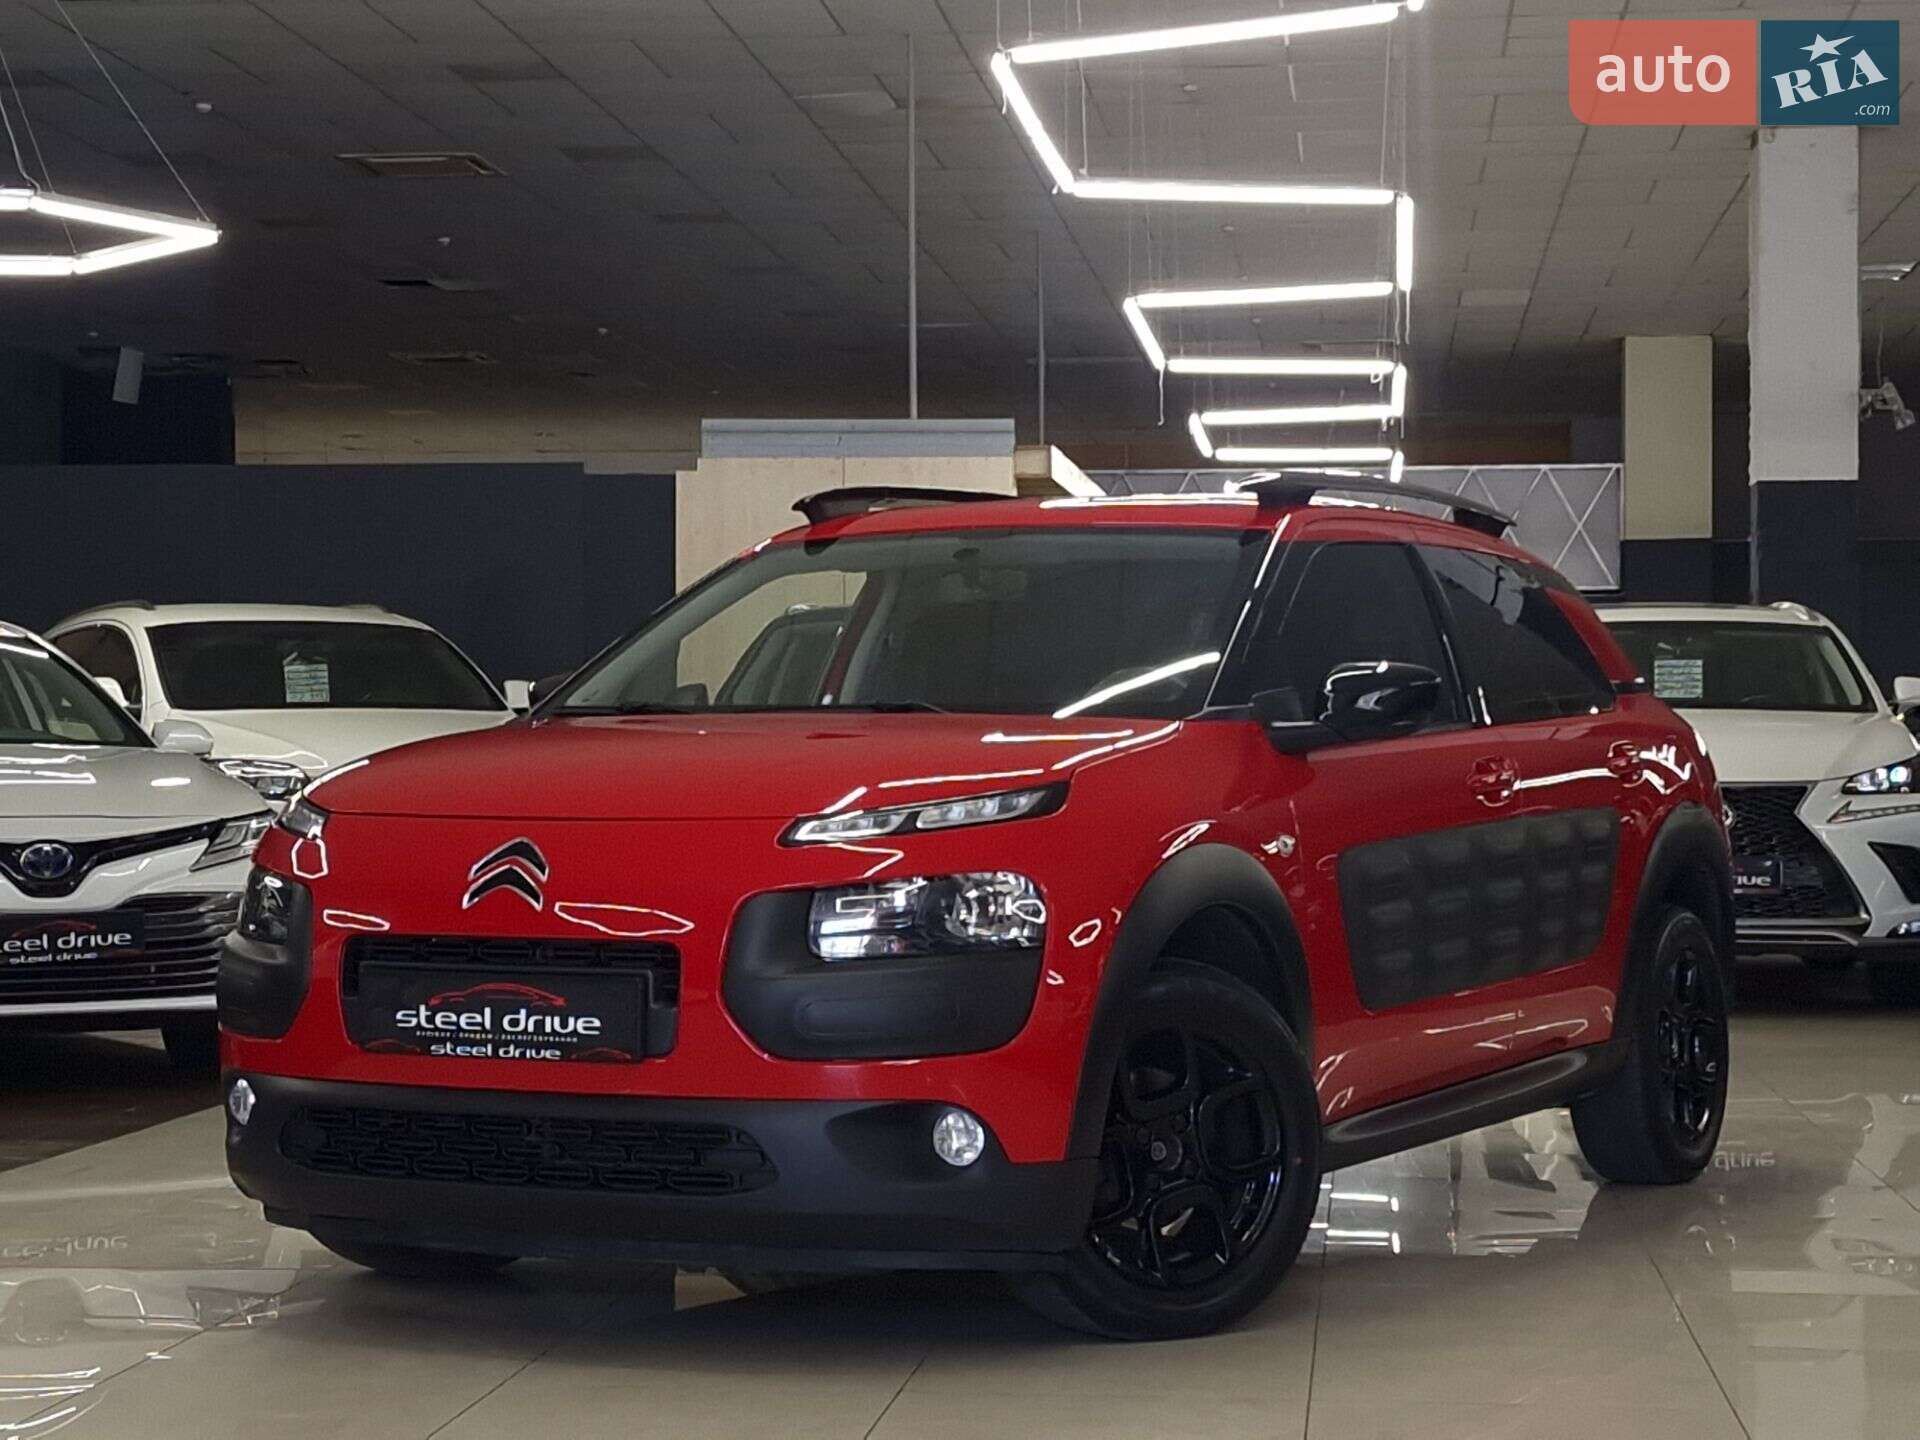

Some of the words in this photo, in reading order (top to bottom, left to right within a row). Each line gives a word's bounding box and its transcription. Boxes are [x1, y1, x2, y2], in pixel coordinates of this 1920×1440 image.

[0, 933, 48, 953] eel
[57, 931, 132, 949] drive
[396, 1003, 491, 1031] steel
[503, 1008, 602, 1035] drive
[429, 1041, 493, 1059] steel
[498, 1044, 562, 1061] drive
